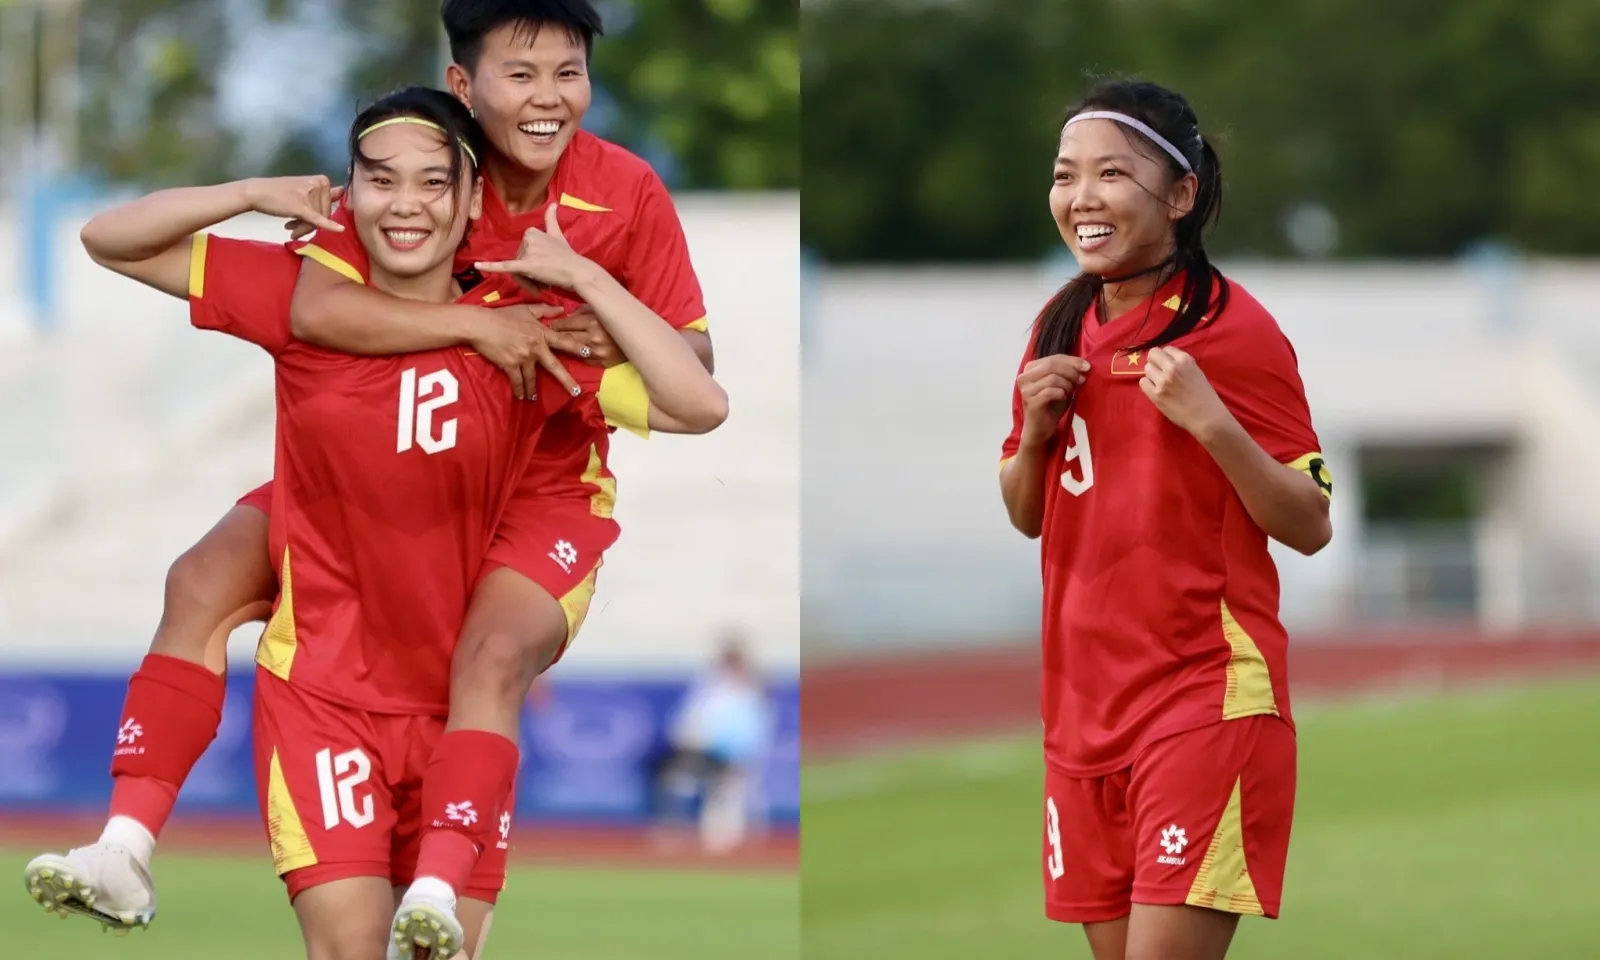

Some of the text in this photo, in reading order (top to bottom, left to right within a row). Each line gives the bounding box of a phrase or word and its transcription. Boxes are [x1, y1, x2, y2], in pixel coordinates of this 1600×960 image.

[396, 366, 459, 455] 12
[1060, 412, 1094, 497] 9
[315, 747, 375, 831] 12
[1046, 796, 1065, 882] 9
